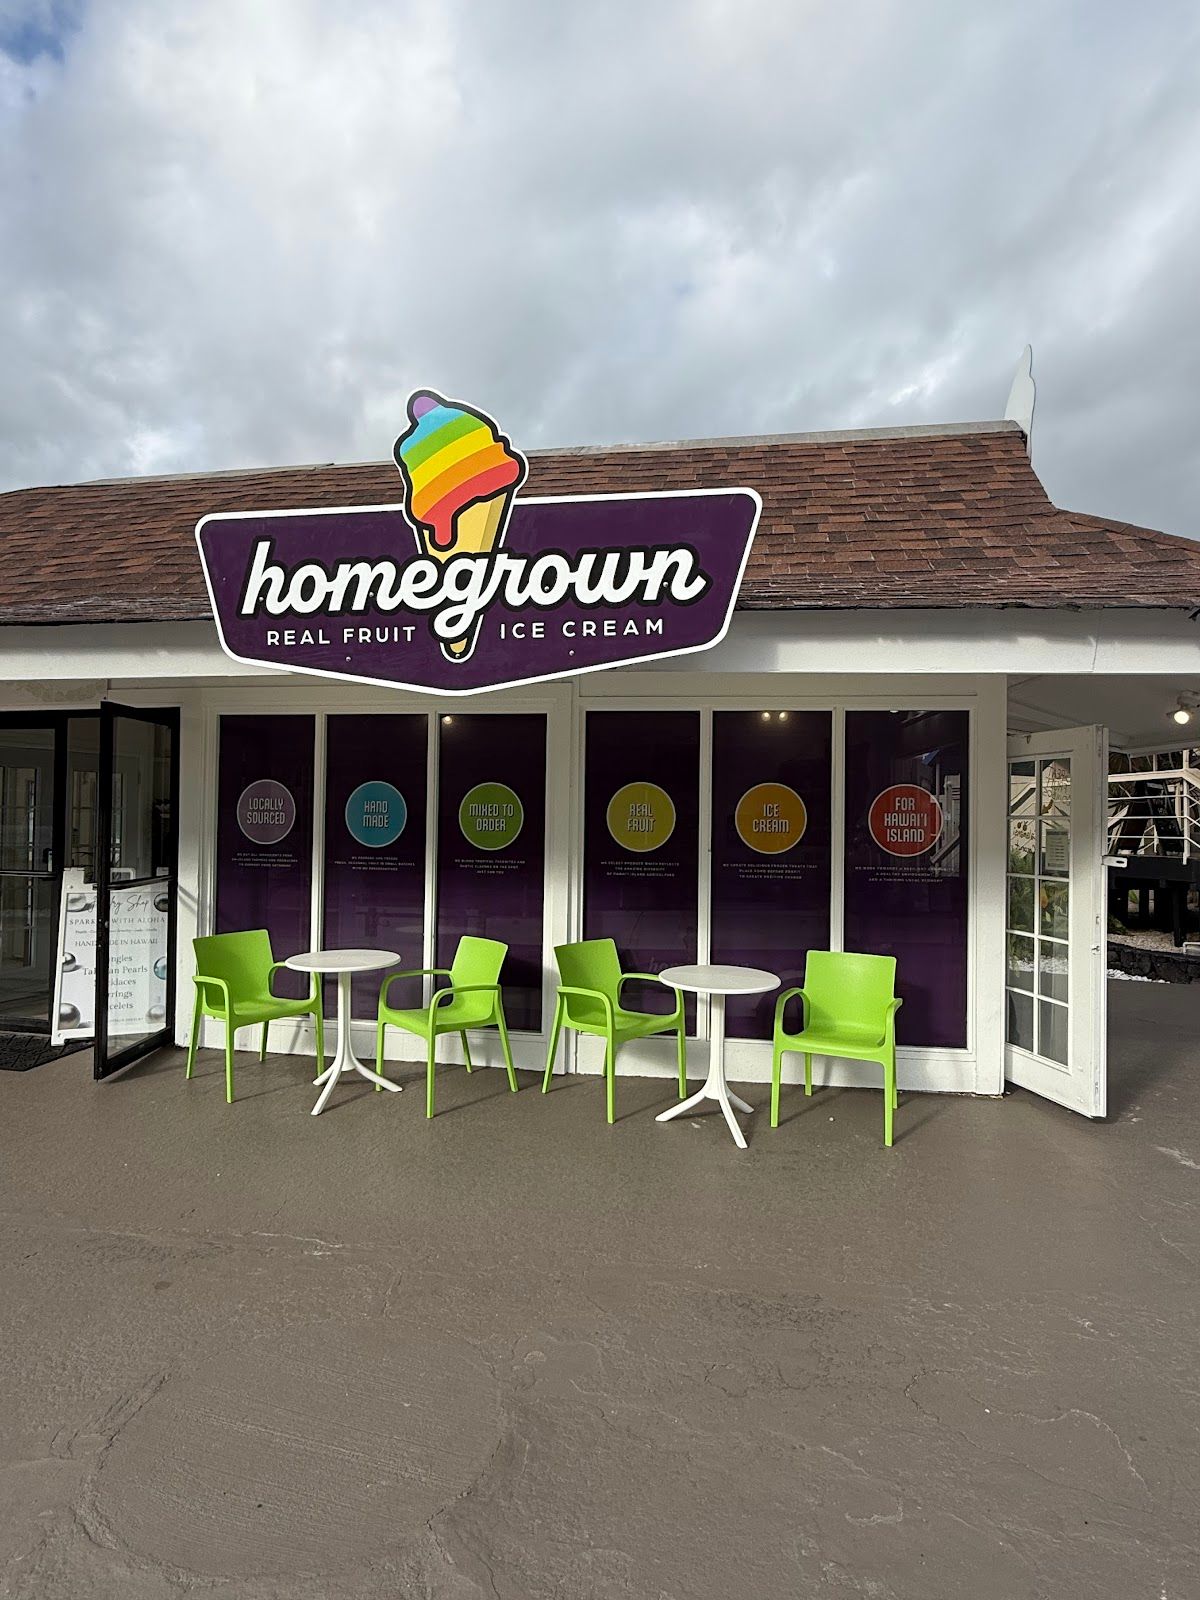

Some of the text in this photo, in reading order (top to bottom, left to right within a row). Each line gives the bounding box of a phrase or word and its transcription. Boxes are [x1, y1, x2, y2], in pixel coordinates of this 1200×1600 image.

[241, 541, 707, 638] homegrown
[266, 618, 664, 646] REAL FRUIT ICE CREAM
[249, 797, 284, 811] LOCALLY
[364, 800, 388, 813] HAND
[469, 803, 515, 817] MIXED TO
[629, 803, 653, 816] REAL
[763, 803, 779, 817] ICE
[895, 797, 916, 811] FOR
[246, 812, 286, 825] SOURCED
[363, 815, 389, 828] MADE
[476, 818, 507, 832] ORDER
[627, 818, 655, 832] FRUIT
[884, 812, 928, 827] HAWAI'I
[752, 819, 789, 833] CREAM
[886, 828, 925, 842] ISLAND
[126, 894, 150, 912] Shop
[110, 954, 133, 964] ngles
[122, 965, 148, 973] Pearls
[109, 1002, 134, 1010] celets
